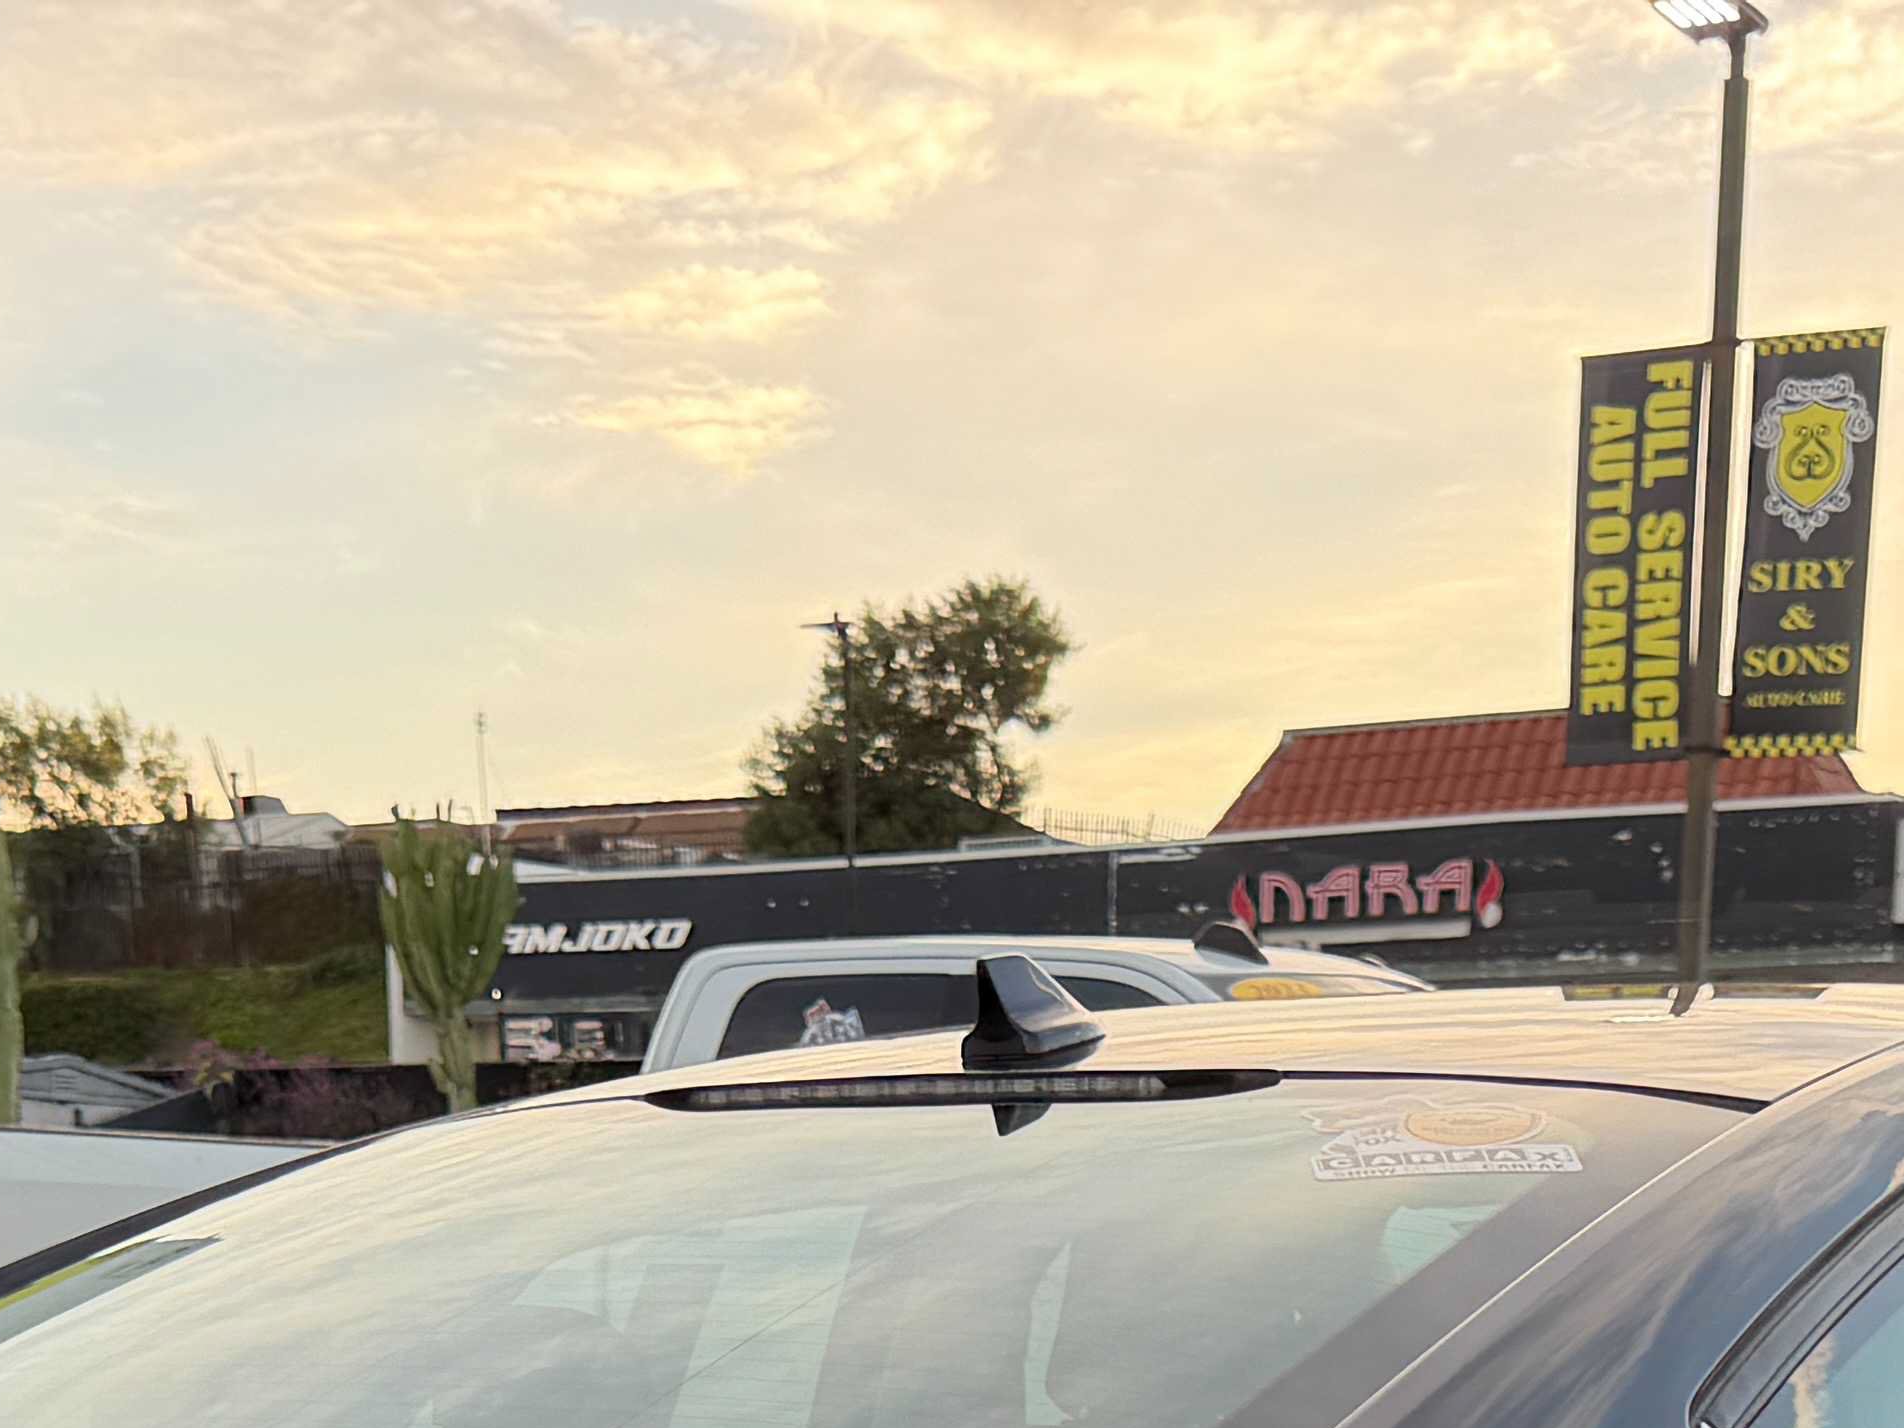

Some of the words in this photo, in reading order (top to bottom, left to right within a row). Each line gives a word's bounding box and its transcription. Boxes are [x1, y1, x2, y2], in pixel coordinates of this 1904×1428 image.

[1640, 360, 1694, 489] FULL
[1586, 405, 1637, 557] AUTO
[1747, 560, 1855, 593] SIRY
[1779, 604, 1816, 631] &
[1579, 565, 1631, 717] CARE
[1632, 510, 1686, 752] SERVICE
[1742, 643, 1851, 678] SONS
[1259, 858, 1474, 924] NARA
